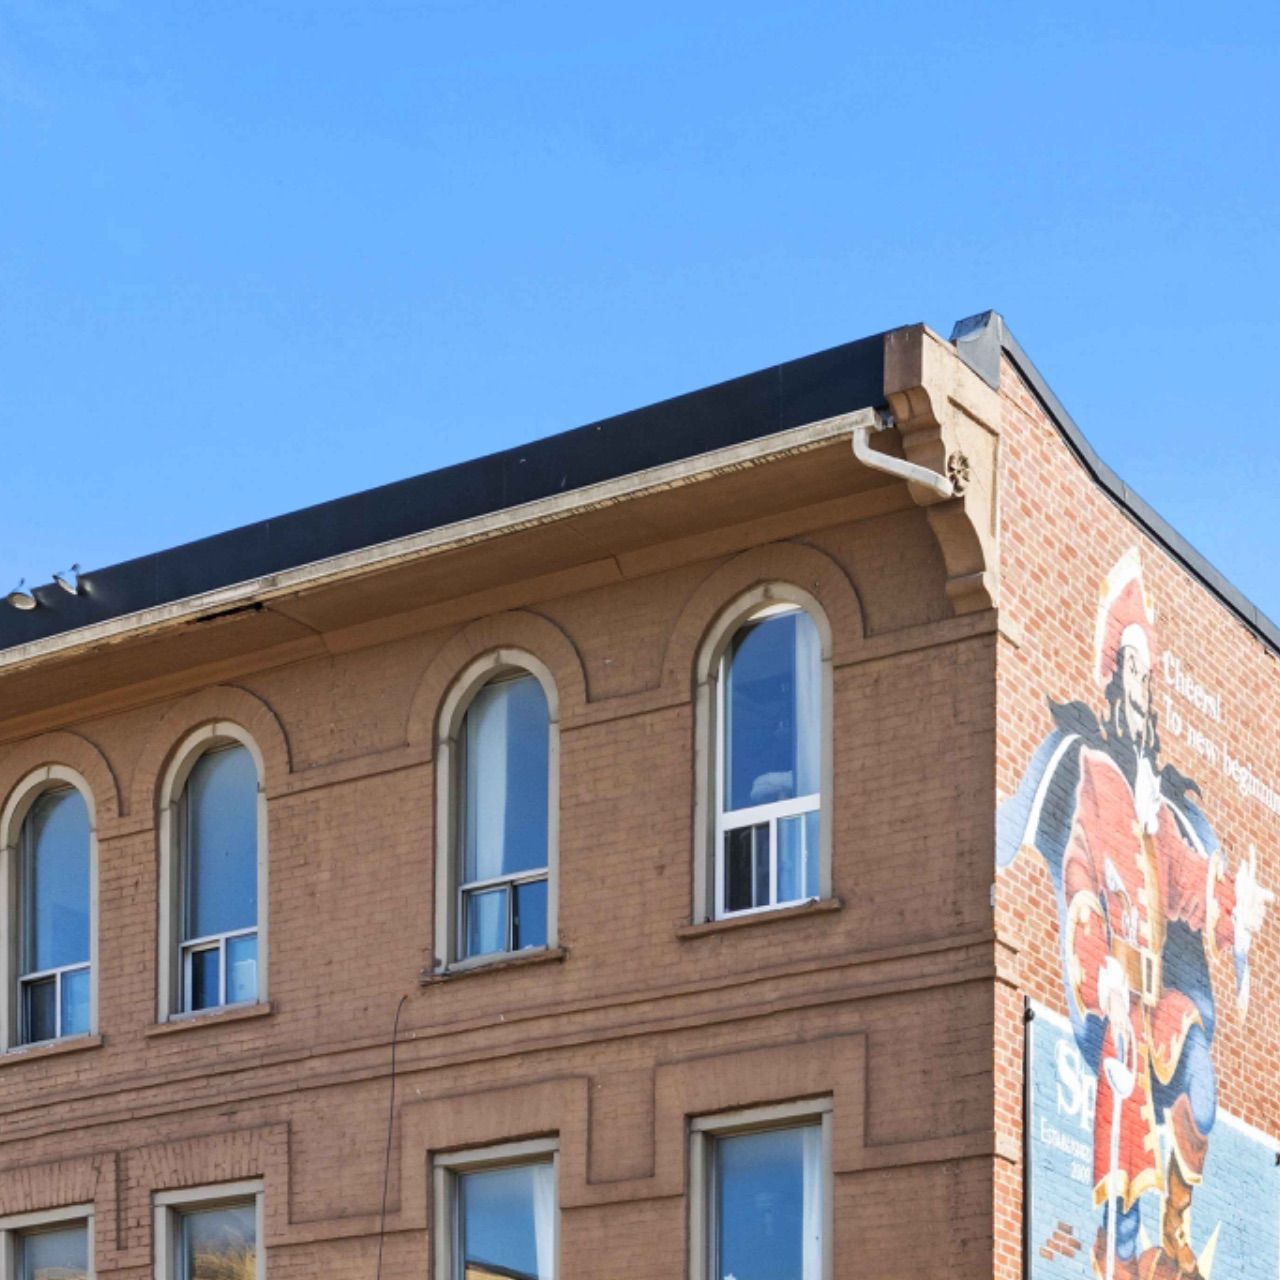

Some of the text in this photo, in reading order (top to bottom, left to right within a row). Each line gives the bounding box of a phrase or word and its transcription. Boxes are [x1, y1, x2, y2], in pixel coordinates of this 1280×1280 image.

[1160, 650, 1221, 722] Cheers!
[1164, 695, 1182, 736] To
[1187, 726, 1216, 767] new
